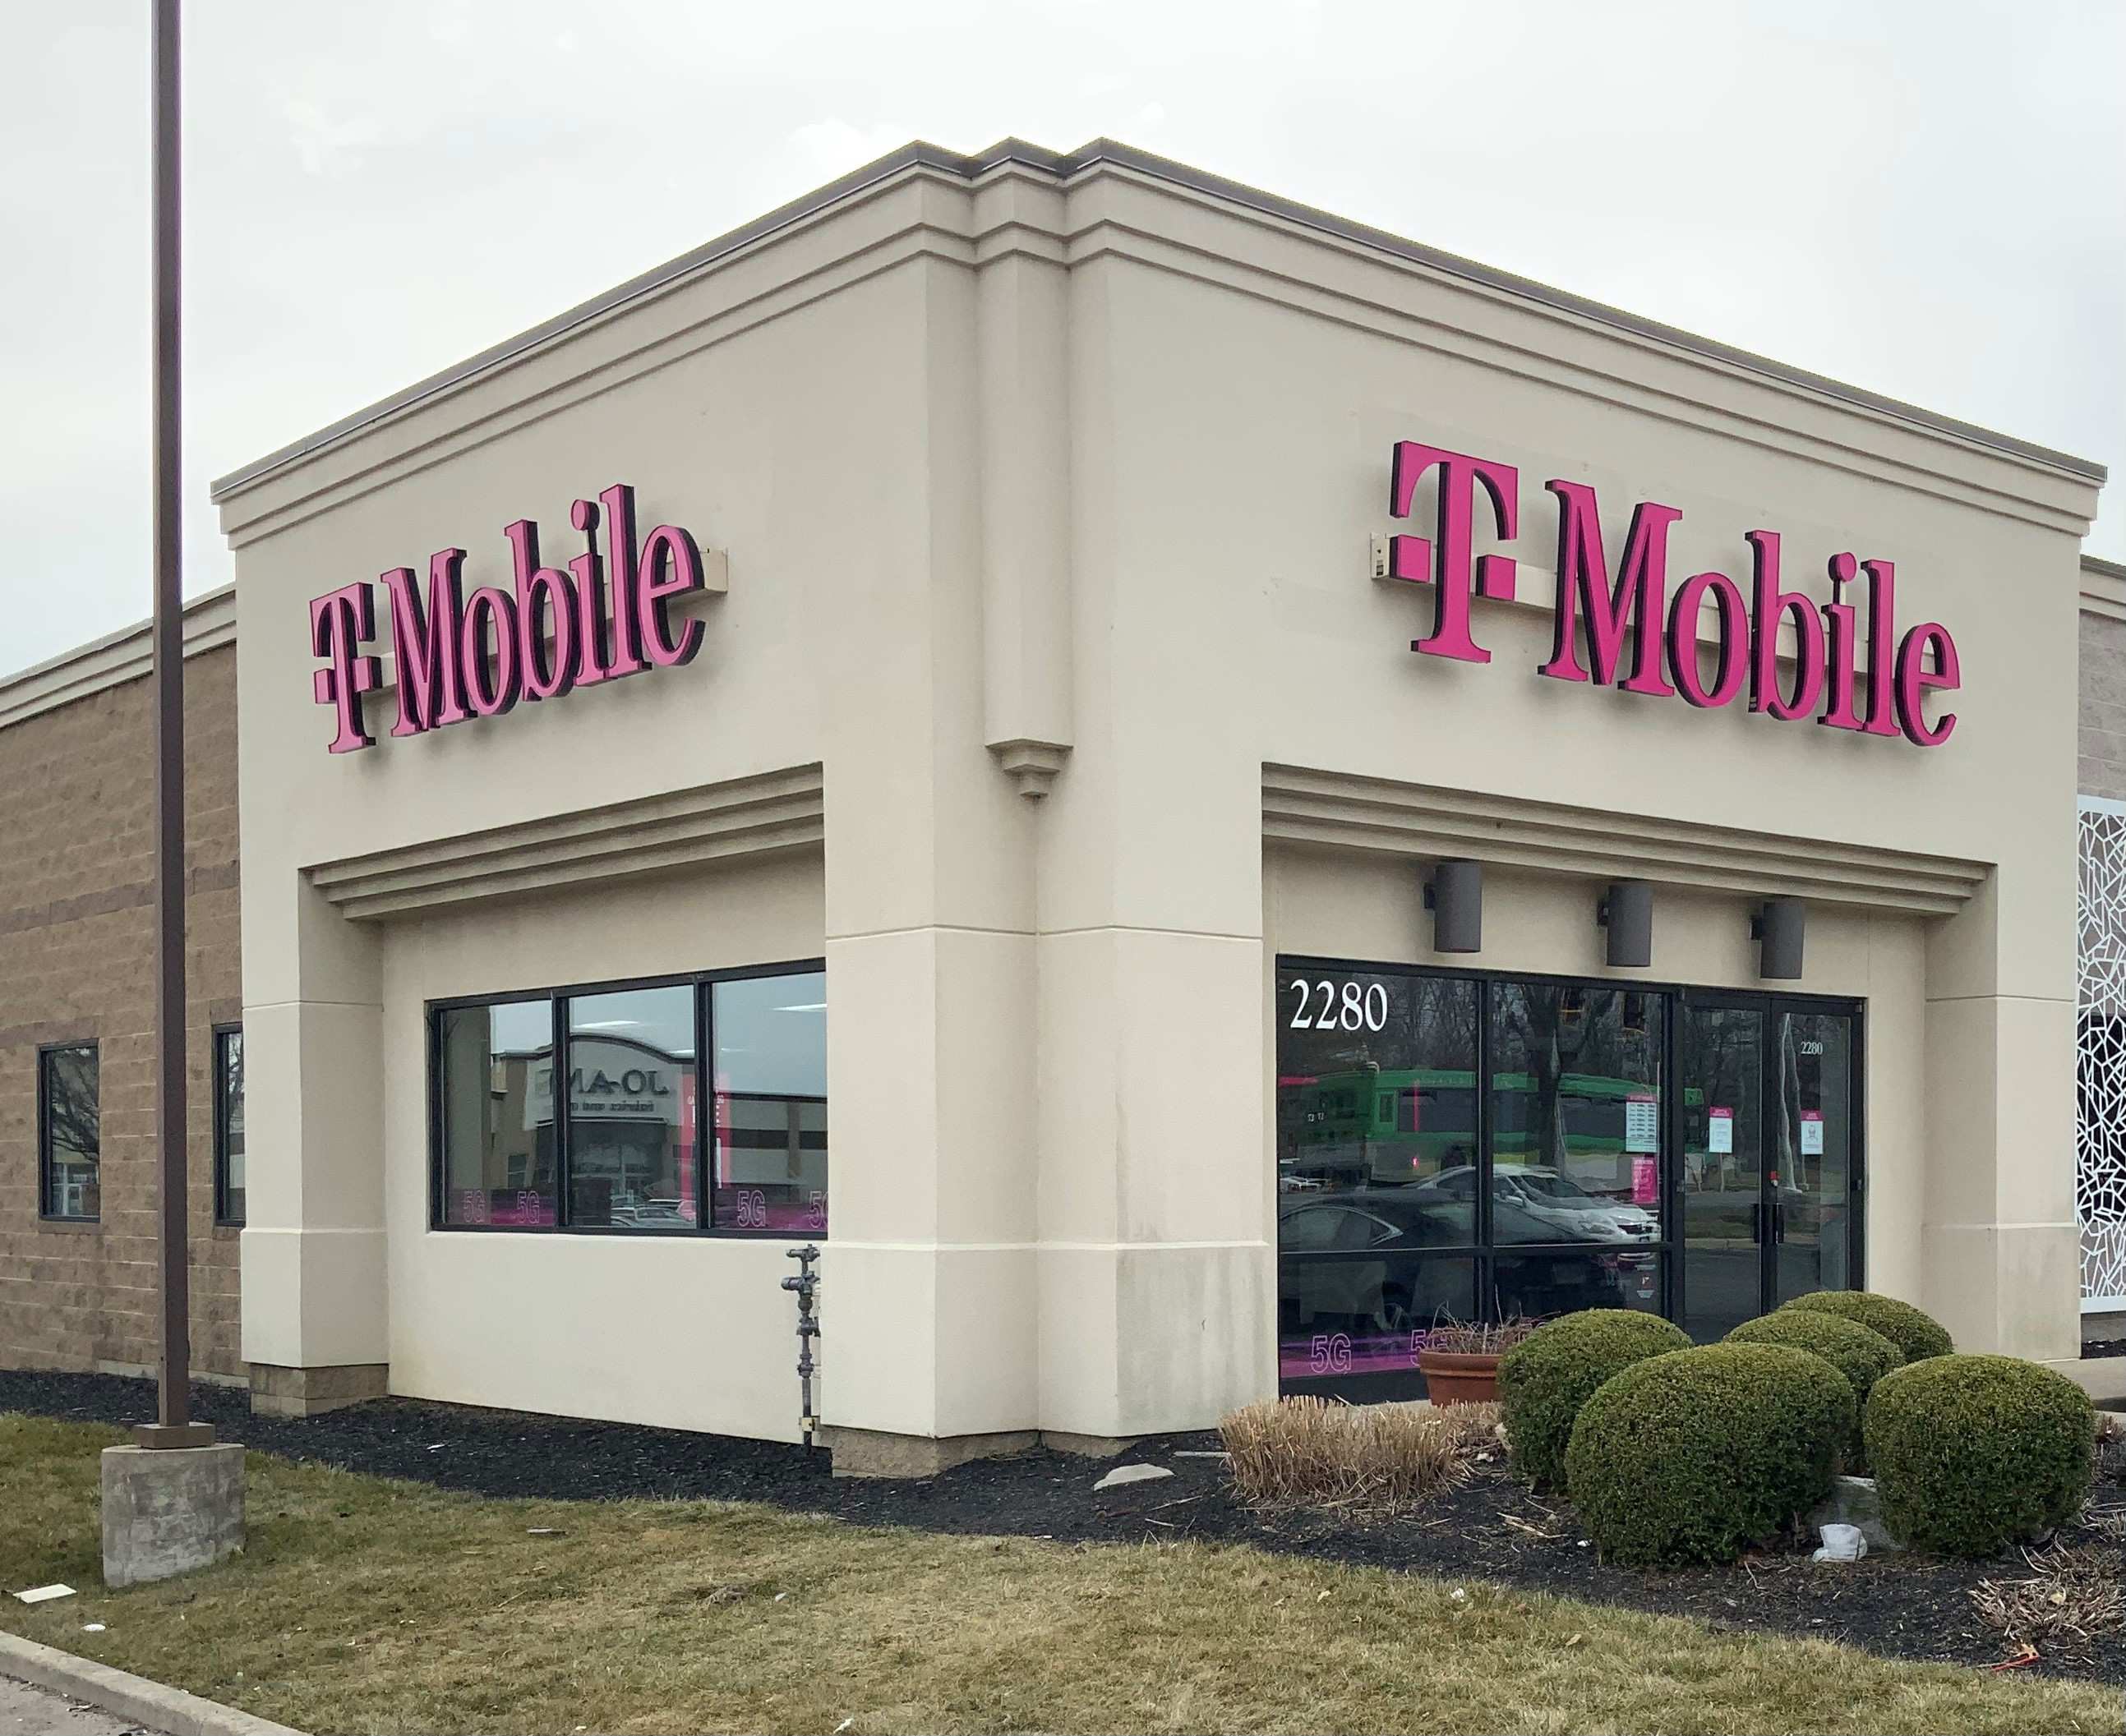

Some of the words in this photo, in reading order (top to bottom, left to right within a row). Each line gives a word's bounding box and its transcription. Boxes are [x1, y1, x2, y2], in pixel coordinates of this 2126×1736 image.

[1290, 979, 1387, 1032] 2280
[1801, 1041, 1823, 1055] 2280
[517, 1190, 540, 1224] 5G
[737, 1190, 767, 1227] 5G
[1310, 1333, 1352, 1374] 5G
